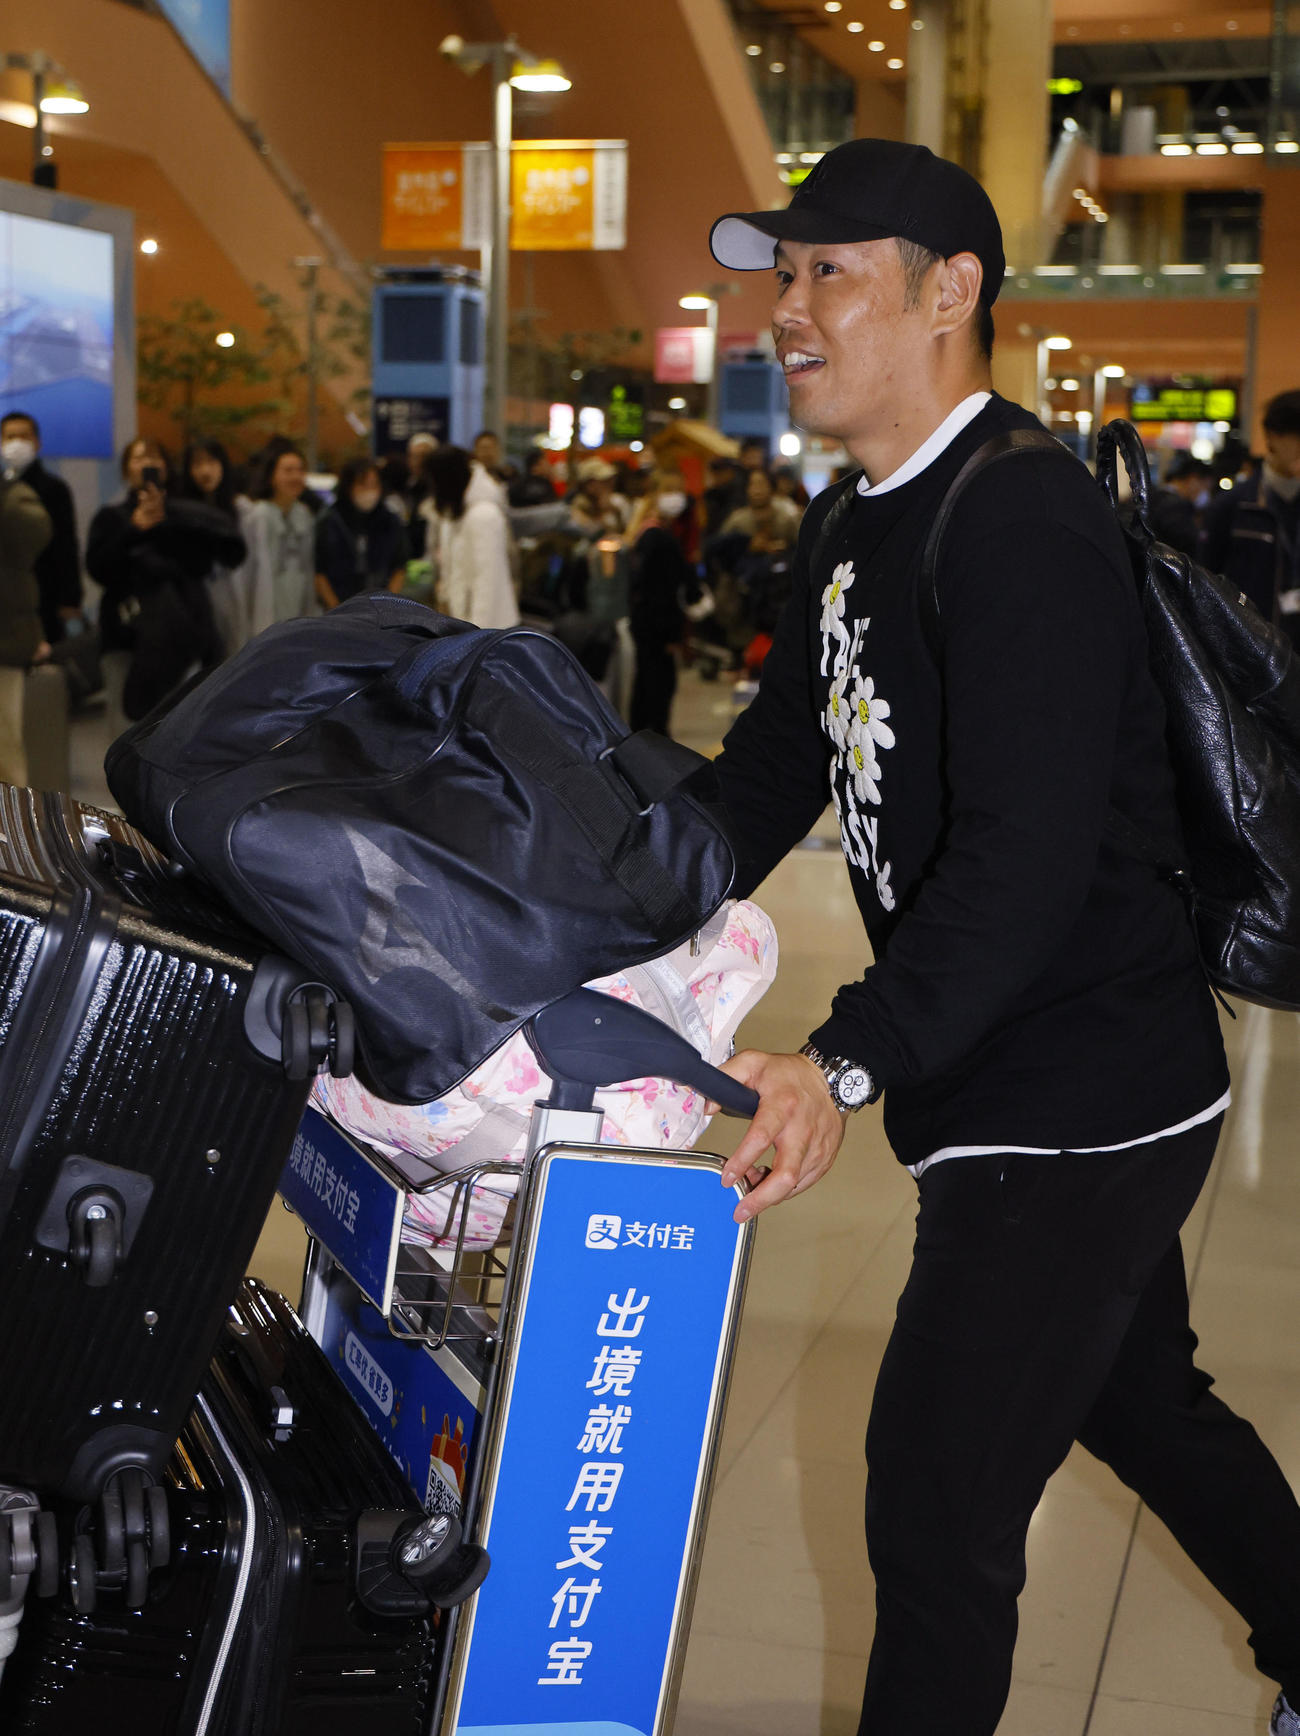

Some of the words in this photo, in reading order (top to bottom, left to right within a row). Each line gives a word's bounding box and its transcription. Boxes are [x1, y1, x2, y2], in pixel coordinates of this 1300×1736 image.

[834, 804, 879, 881] ASY
[622, 1221, 695, 1250] 支付宝
[537, 1287, 651, 1686] 出境就用支付宝
